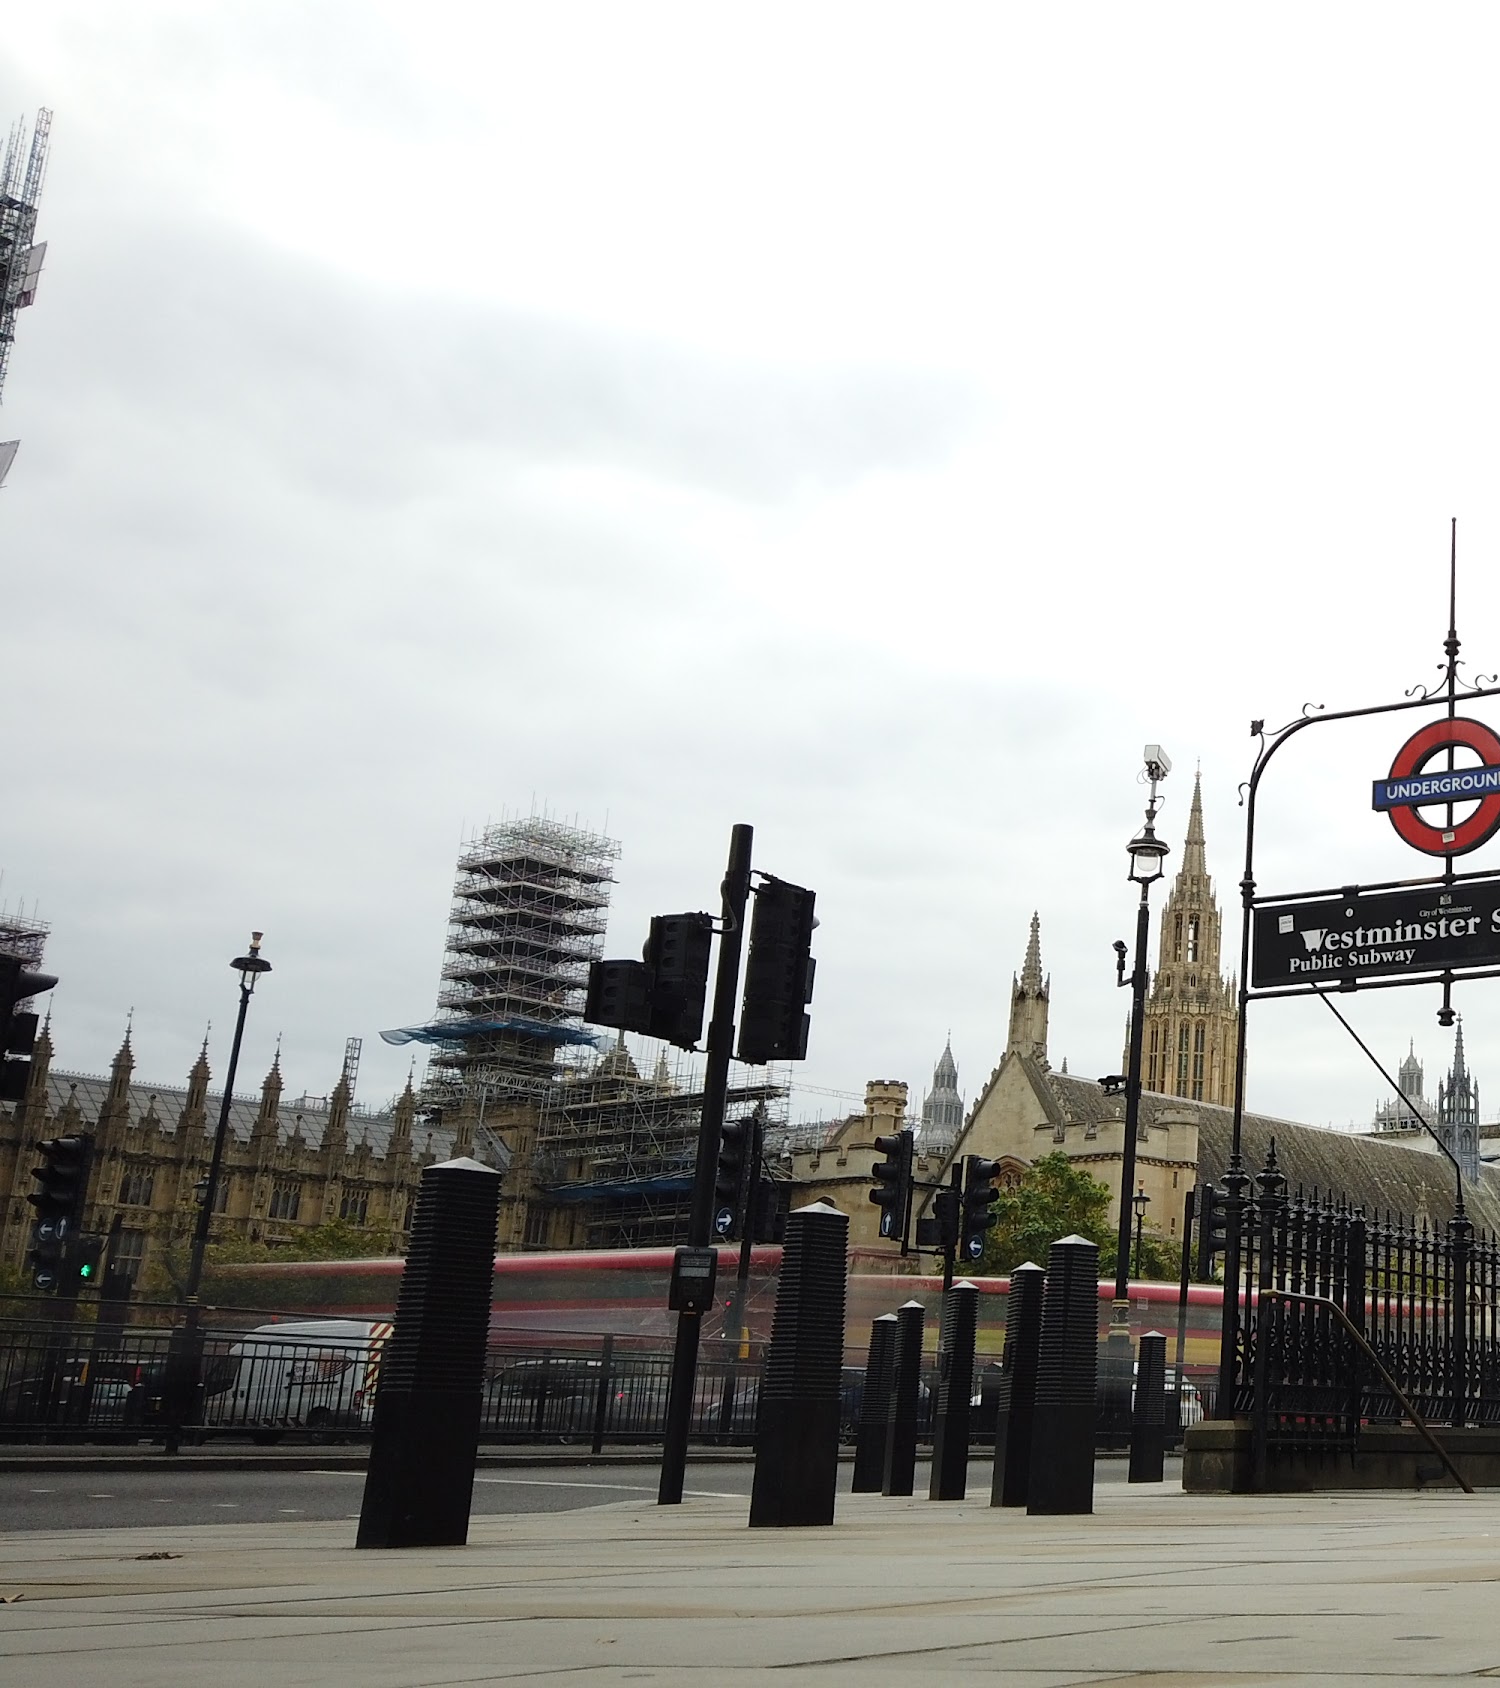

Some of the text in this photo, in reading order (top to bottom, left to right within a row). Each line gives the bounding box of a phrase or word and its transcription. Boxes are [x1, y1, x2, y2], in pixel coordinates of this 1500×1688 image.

[1419, 906, 1473, 918] City of Westminster
[1289, 948, 1416, 973] Public Subway
